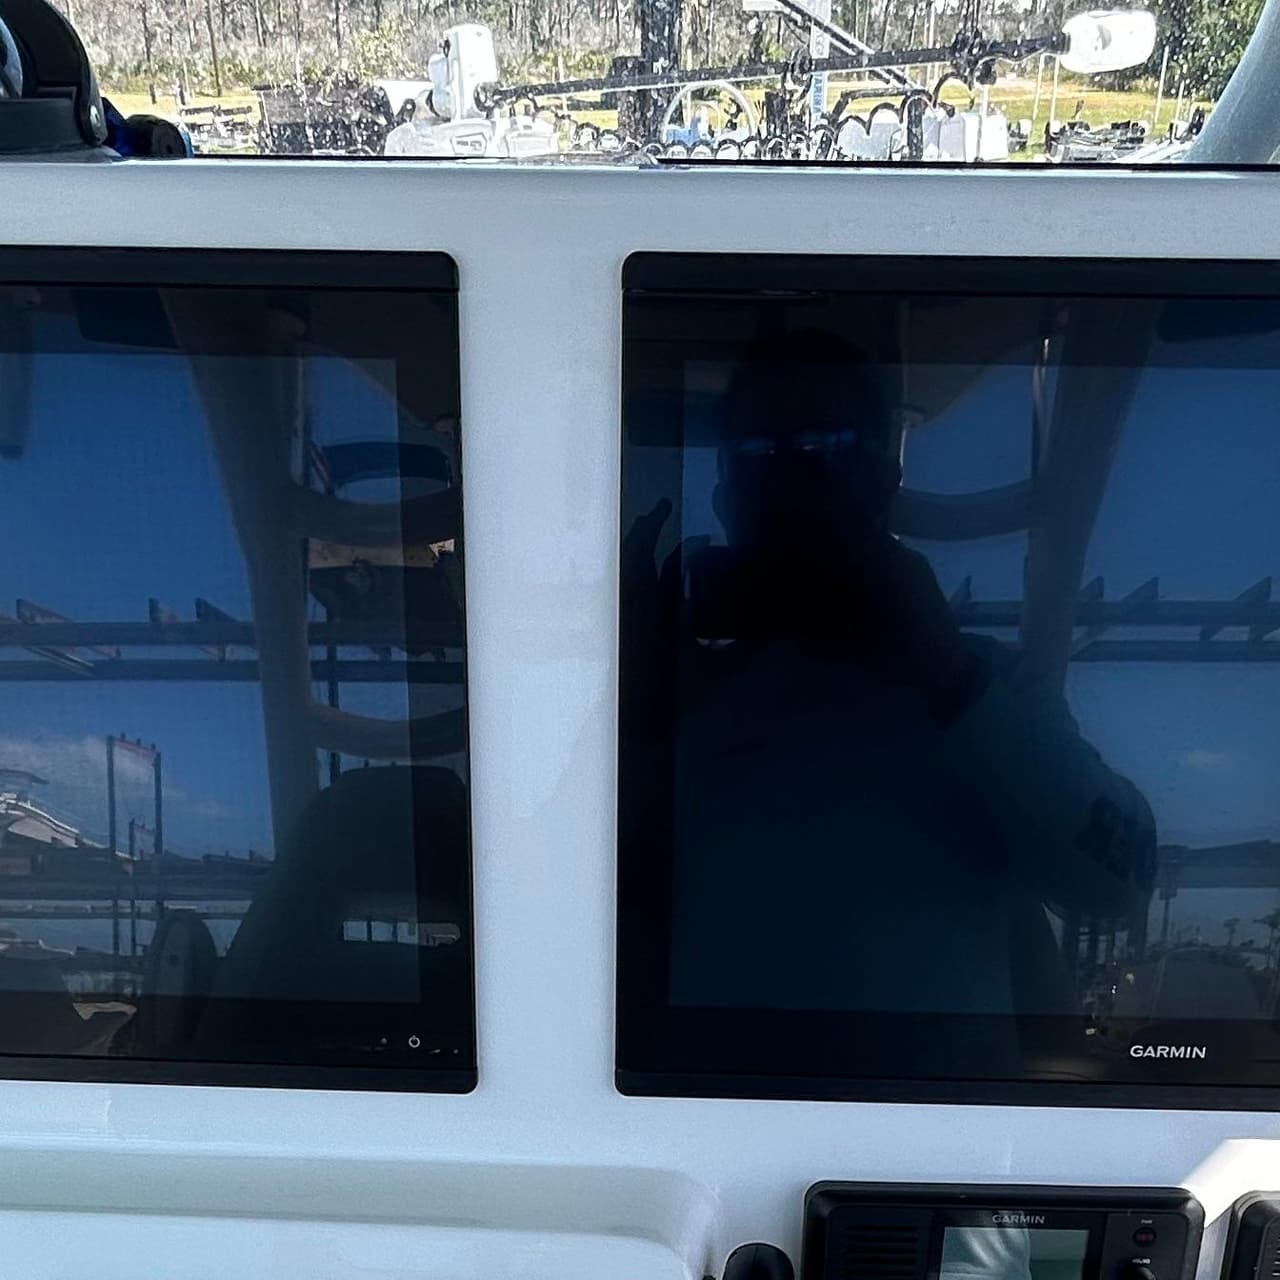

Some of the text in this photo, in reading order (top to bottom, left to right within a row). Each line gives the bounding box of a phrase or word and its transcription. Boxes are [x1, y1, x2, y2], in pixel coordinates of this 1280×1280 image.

[812, 73, 824, 114] ARINA
[1129, 1044, 1207, 1059] GARMIN
[992, 1214, 1046, 1225] GARMIN
